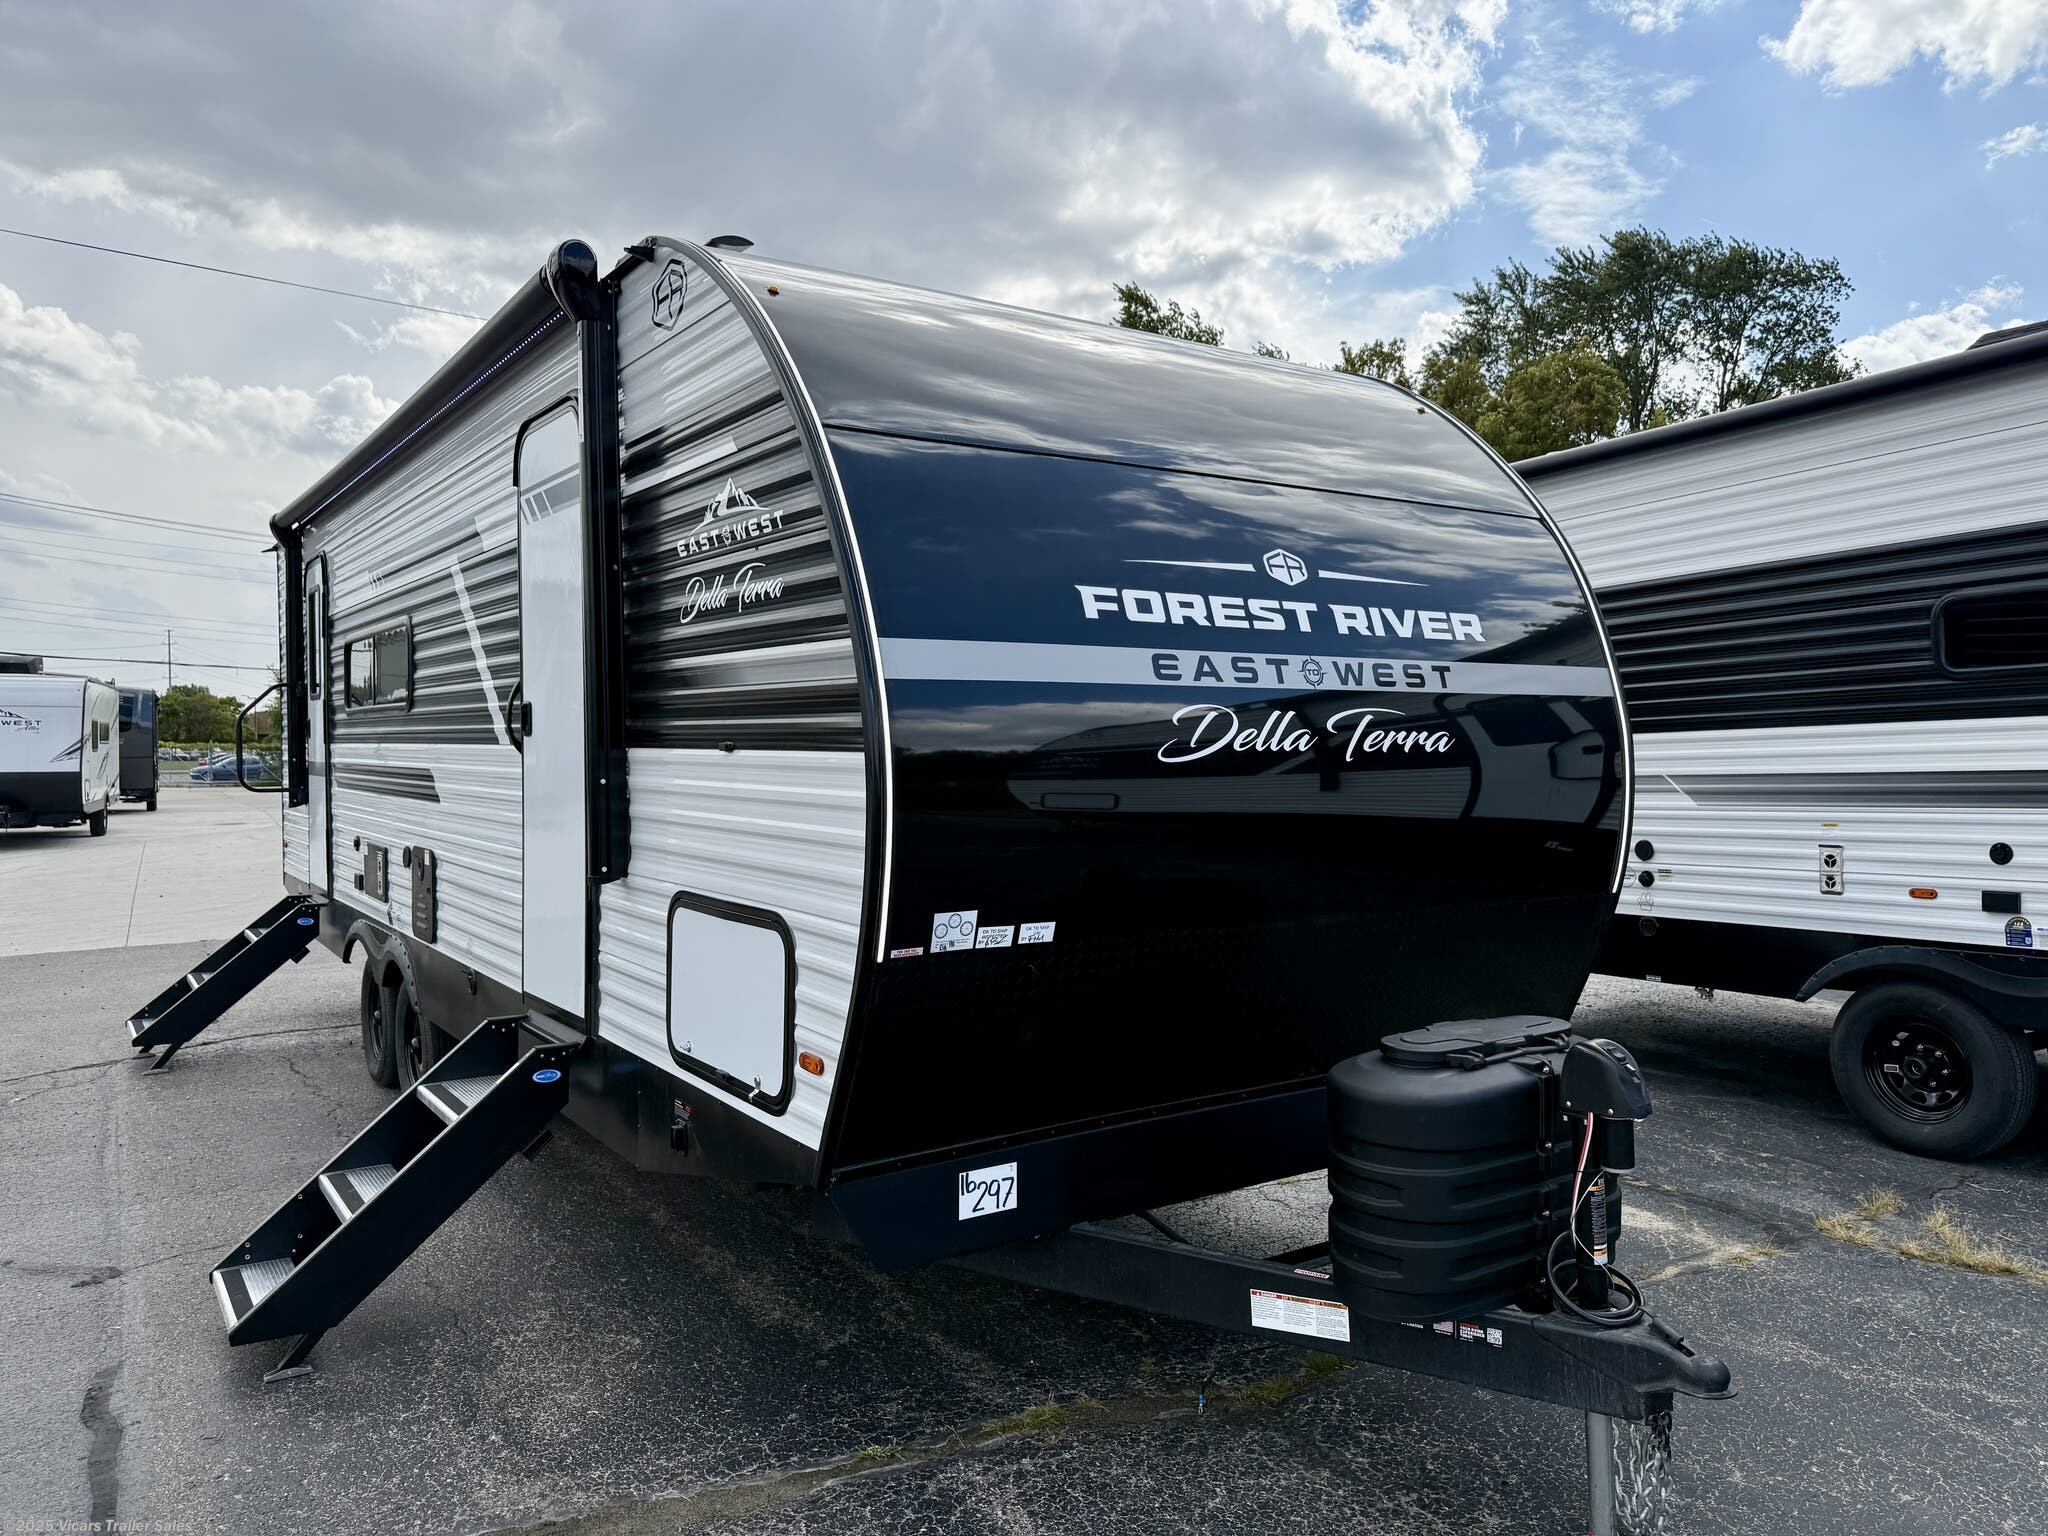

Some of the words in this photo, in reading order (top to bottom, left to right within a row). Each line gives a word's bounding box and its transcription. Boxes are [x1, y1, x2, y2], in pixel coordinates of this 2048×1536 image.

[677, 529, 719, 557] EAST
[733, 510, 784, 541] WEST
[680, 577, 728, 624] Della
[733, 563, 784, 613] Terra
[1074, 585, 1318, 633] FOREST
[1328, 604, 1487, 642] RIVER
[1151, 653, 1290, 685] EAST
[1306, 668, 1320, 677] TO
[1331, 660, 1451, 690] WEST
[1157, 704, 1319, 763] Della
[1326, 707, 1455, 762] Terra
